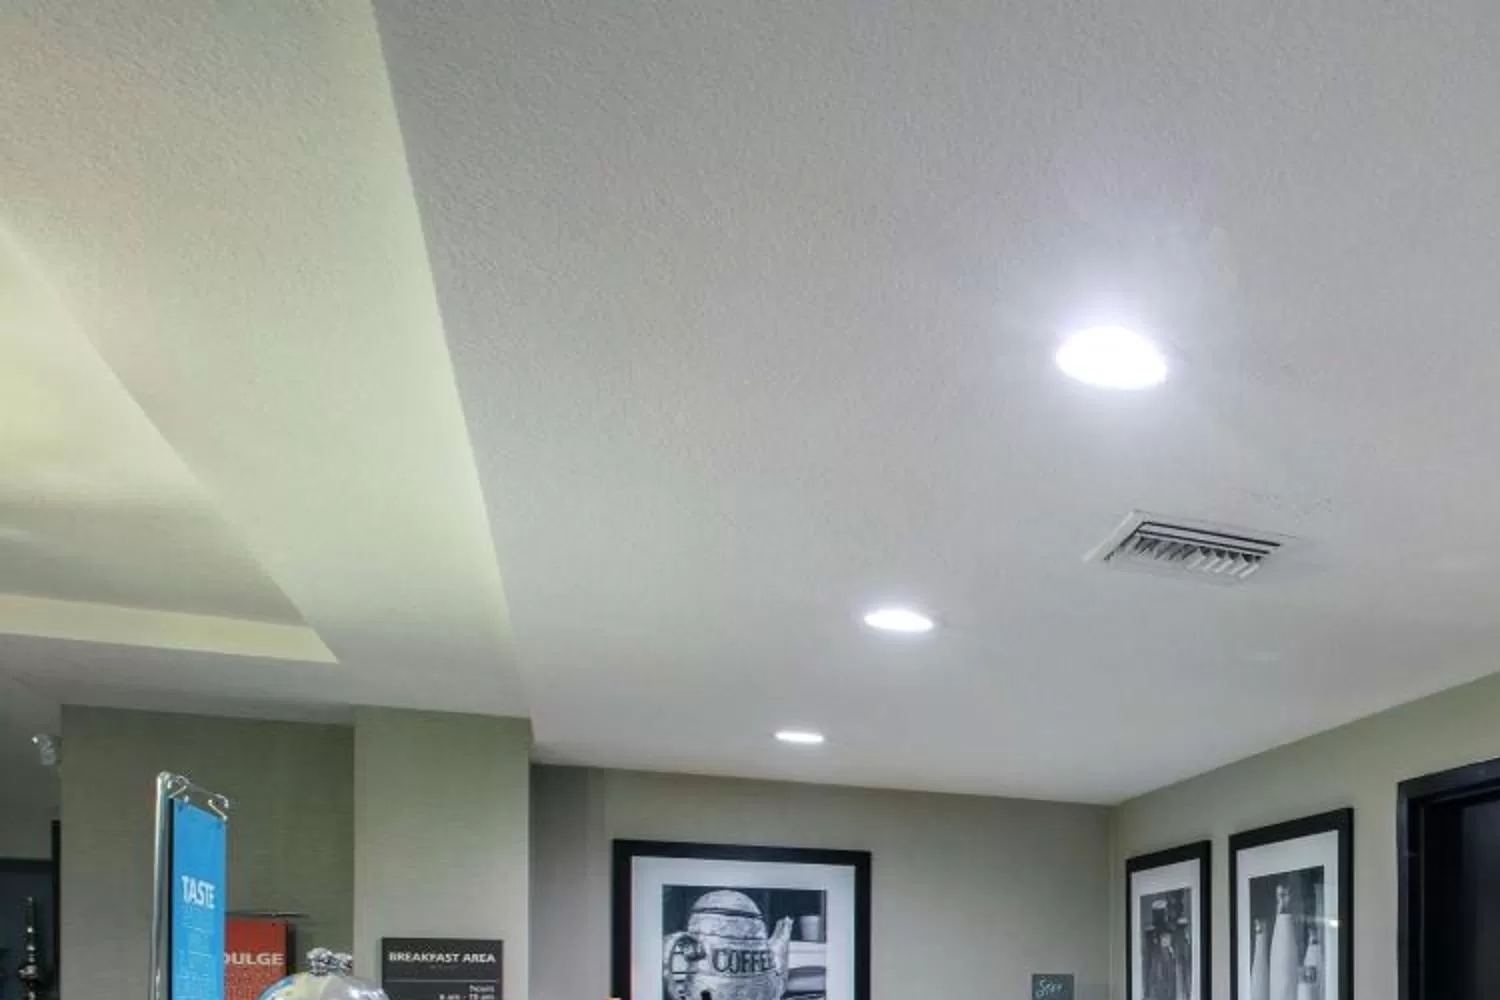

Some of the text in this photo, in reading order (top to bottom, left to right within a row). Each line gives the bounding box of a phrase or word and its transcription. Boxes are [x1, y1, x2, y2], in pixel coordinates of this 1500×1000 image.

[181, 875, 215, 910] TASTE
[223, 952, 285, 966] DULGE
[388, 952, 496, 963] BREAKFAST AREA
[712, 949, 774, 974] COFFEE
